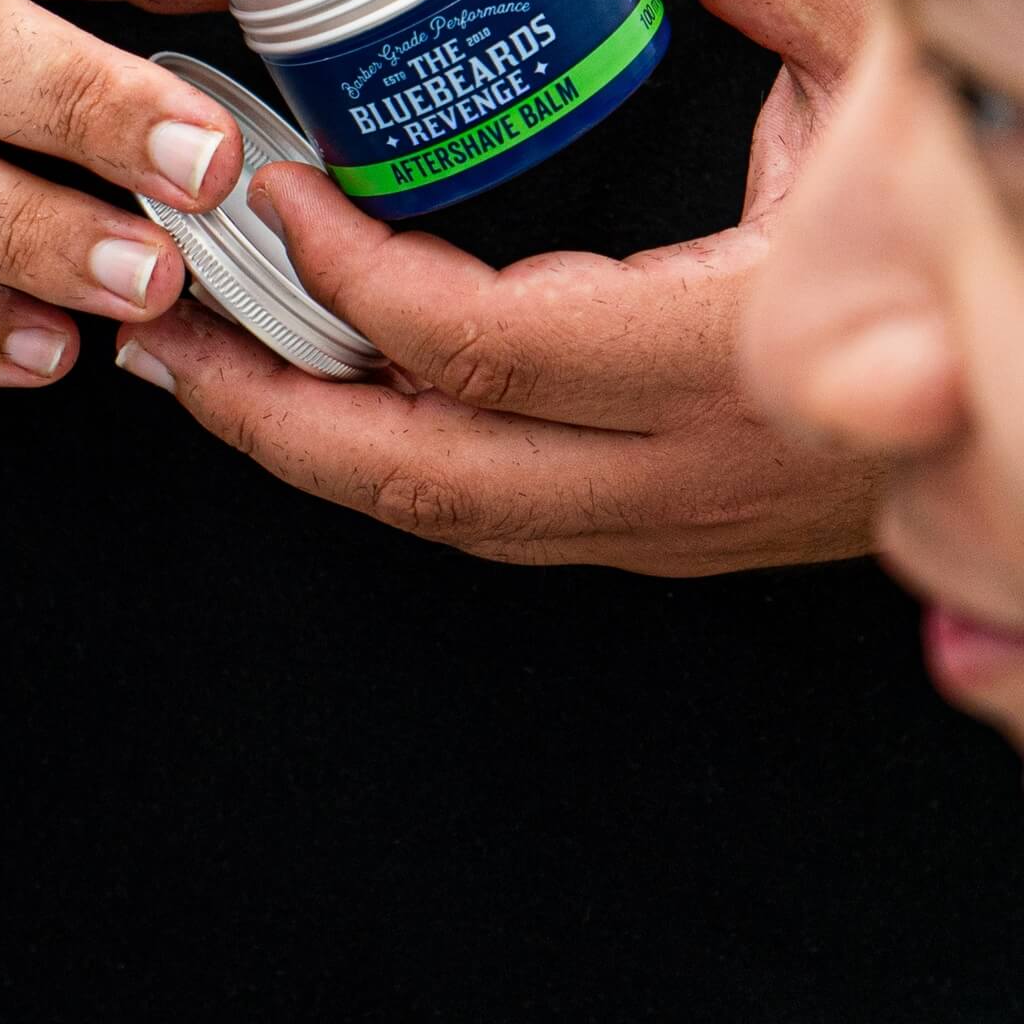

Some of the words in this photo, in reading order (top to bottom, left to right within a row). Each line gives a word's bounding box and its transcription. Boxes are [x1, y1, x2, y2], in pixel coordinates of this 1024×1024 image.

[341, 61, 382, 99] Barber
[378, 31, 428, 67] Grade
[429, 1, 531, 40] Performance
[349, 13, 556, 134] BLUEBEARDS
[407, 38, 466, 79] THE
[465, 27, 491, 47] 2010
[391, 114, 520, 185] AFTERSHAVE
[519, 76, 580, 129] BALM
[403, 69, 530, 146] REVENGE
